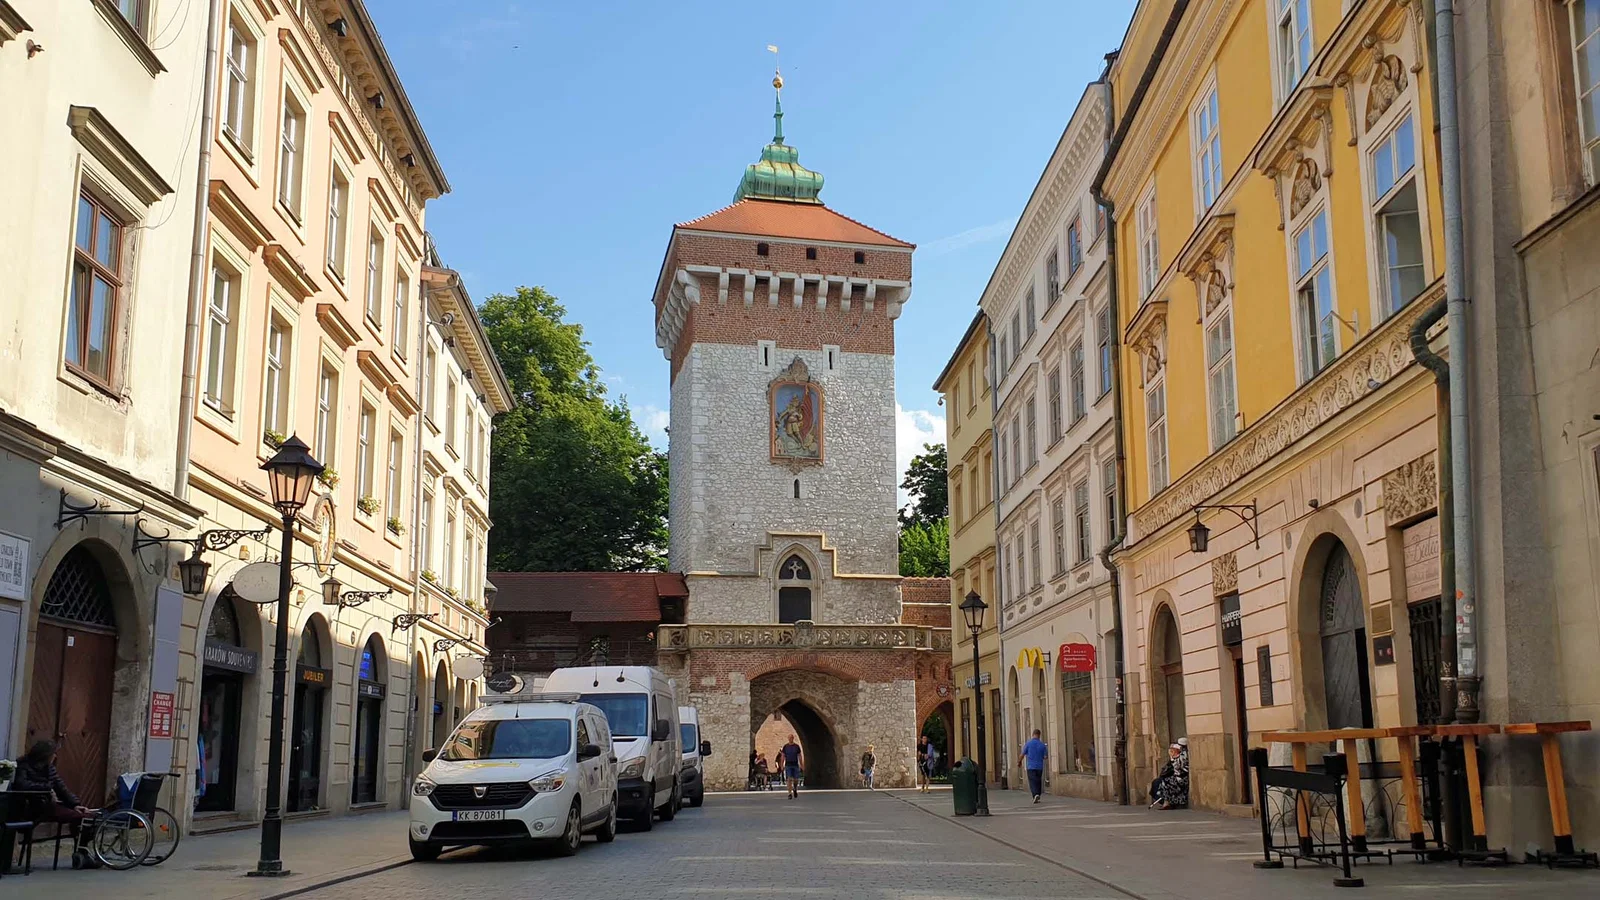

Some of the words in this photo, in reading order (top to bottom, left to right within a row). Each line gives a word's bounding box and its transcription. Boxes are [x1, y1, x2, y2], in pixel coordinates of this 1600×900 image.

[303, 669, 324, 682] JUBILER
[153, 699, 172, 707] CHANGE
[458, 811, 470, 820] KK
[473, 810, 501, 820] 87081
